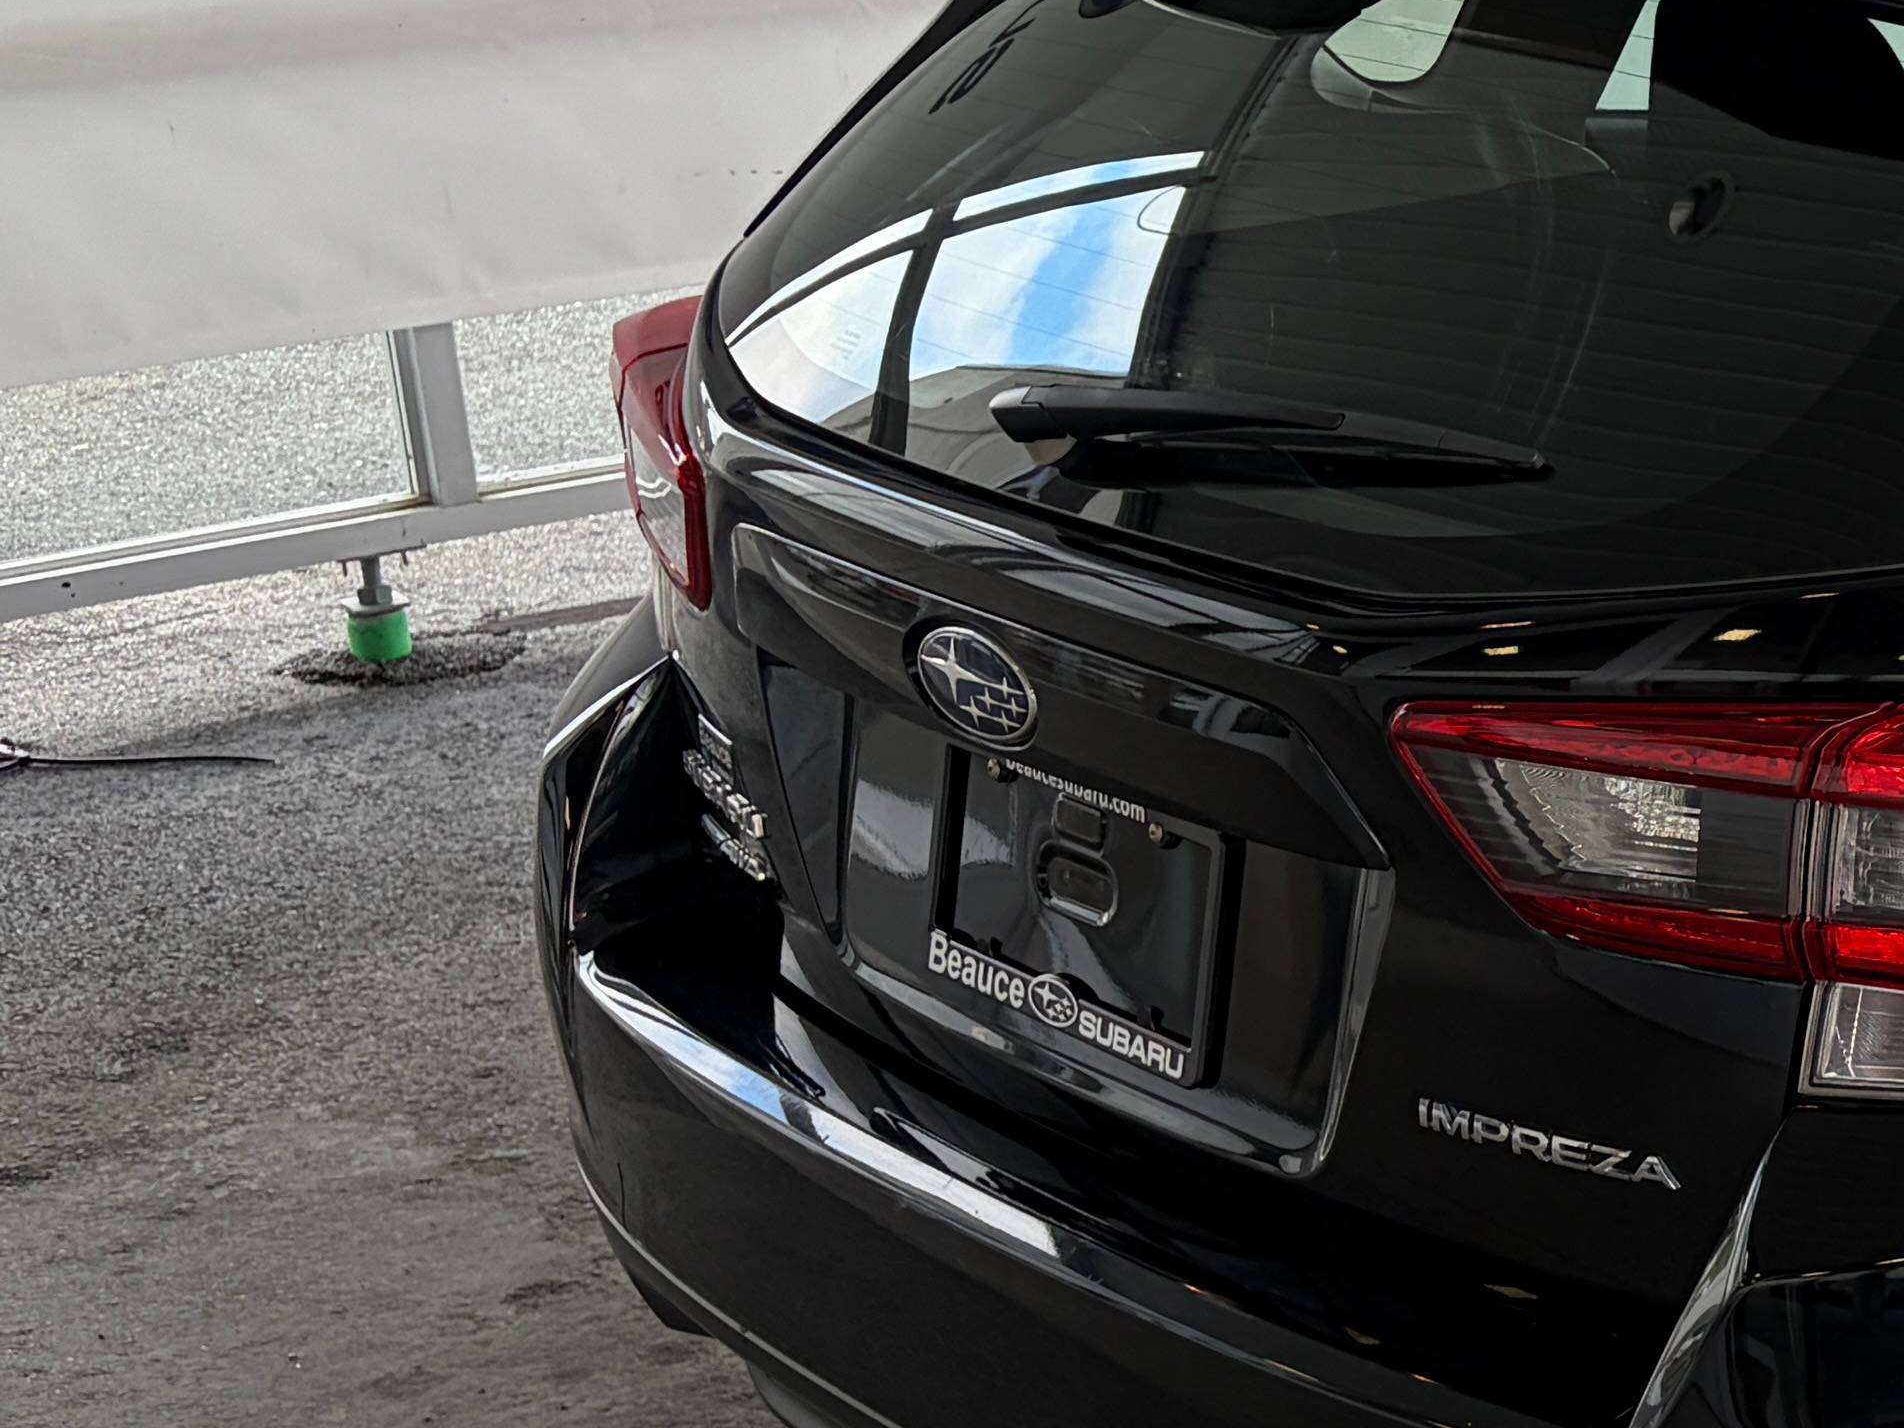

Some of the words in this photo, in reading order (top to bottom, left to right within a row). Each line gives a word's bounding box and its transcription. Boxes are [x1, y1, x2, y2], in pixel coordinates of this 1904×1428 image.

[928, 930, 1025, 1009] Beauce
[1078, 1010, 1184, 1079] SUBARU
[1419, 1098, 1681, 1190] IMPREZA
